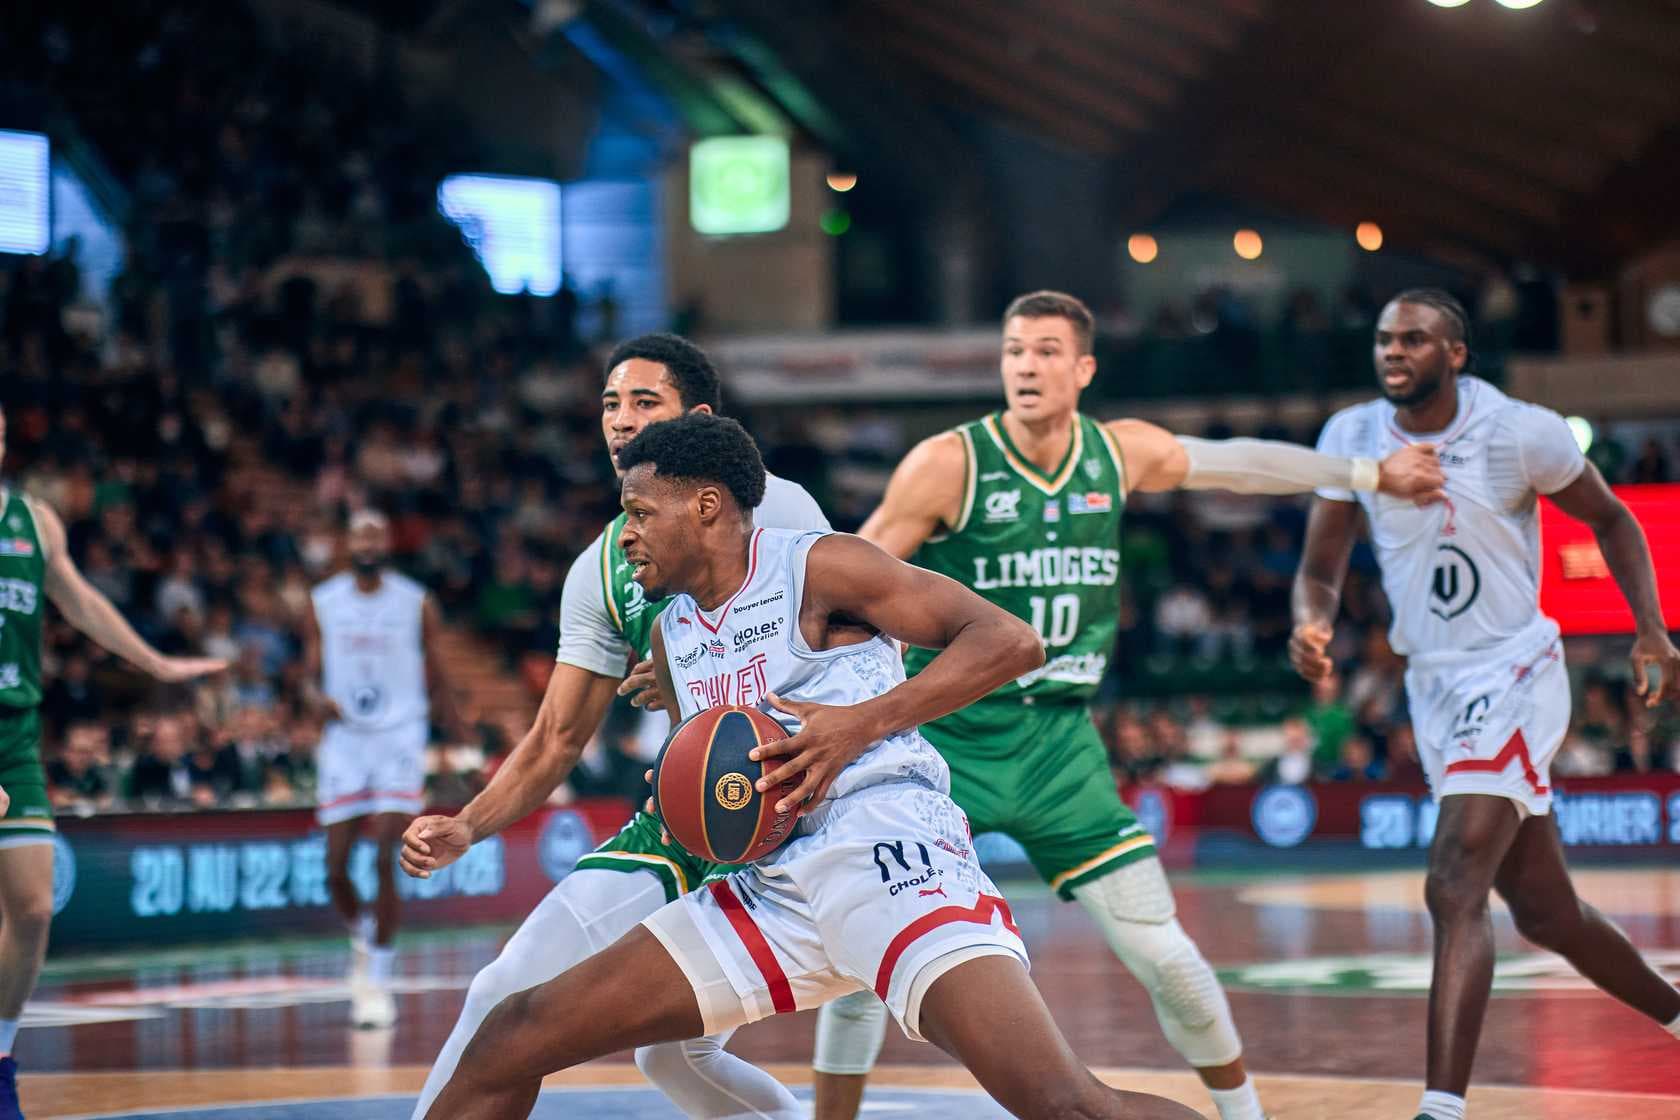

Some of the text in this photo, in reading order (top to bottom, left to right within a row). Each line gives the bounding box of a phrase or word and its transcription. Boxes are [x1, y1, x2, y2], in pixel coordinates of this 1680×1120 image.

[973, 547, 1120, 589] LIMOGES
[733, 593, 783, 614] bouyer leroux
[1030, 594, 1081, 648] 10
